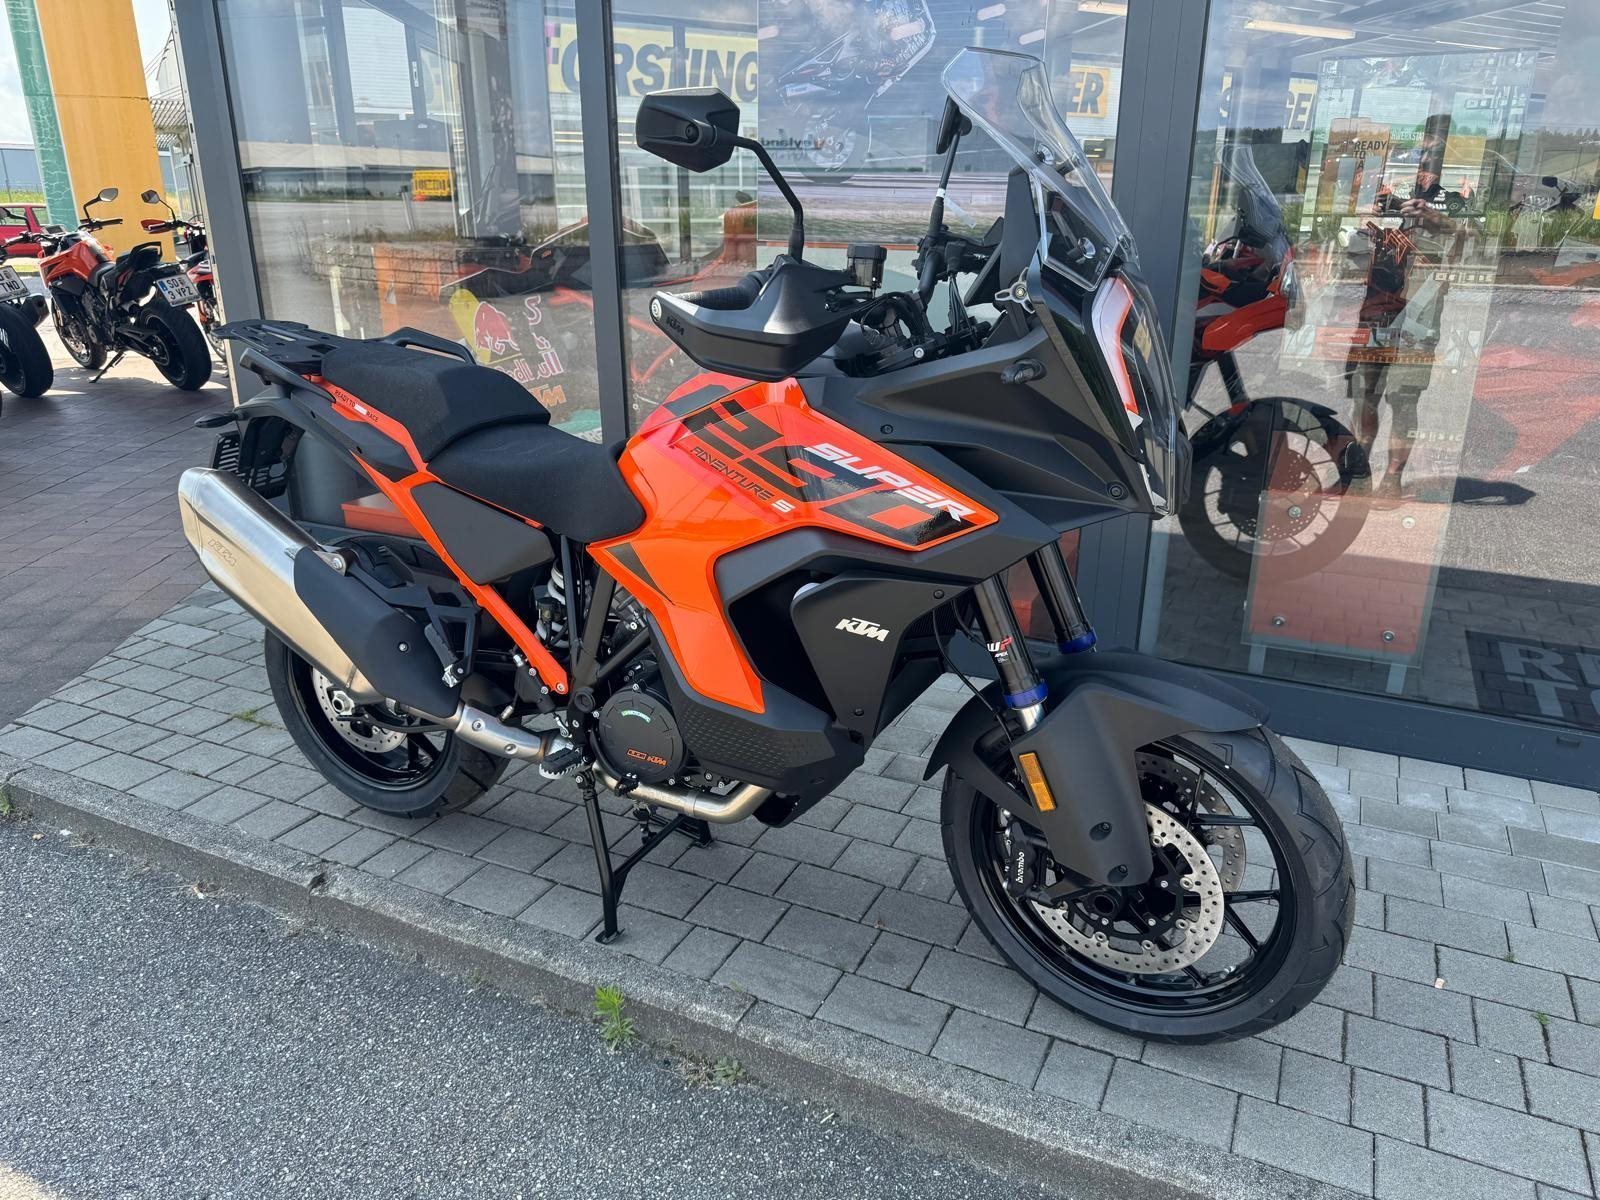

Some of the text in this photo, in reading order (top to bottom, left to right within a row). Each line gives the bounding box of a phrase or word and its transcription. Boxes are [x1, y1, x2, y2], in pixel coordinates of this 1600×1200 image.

[1354, 140, 1388, 150] READY
[690, 446, 775, 501] ADVENTURE
[804, 443, 976, 522] SUPER
[835, 617, 889, 642] KTM
[647, 756, 667, 766] KTM
[1016, 851, 1025, 884] brembo
